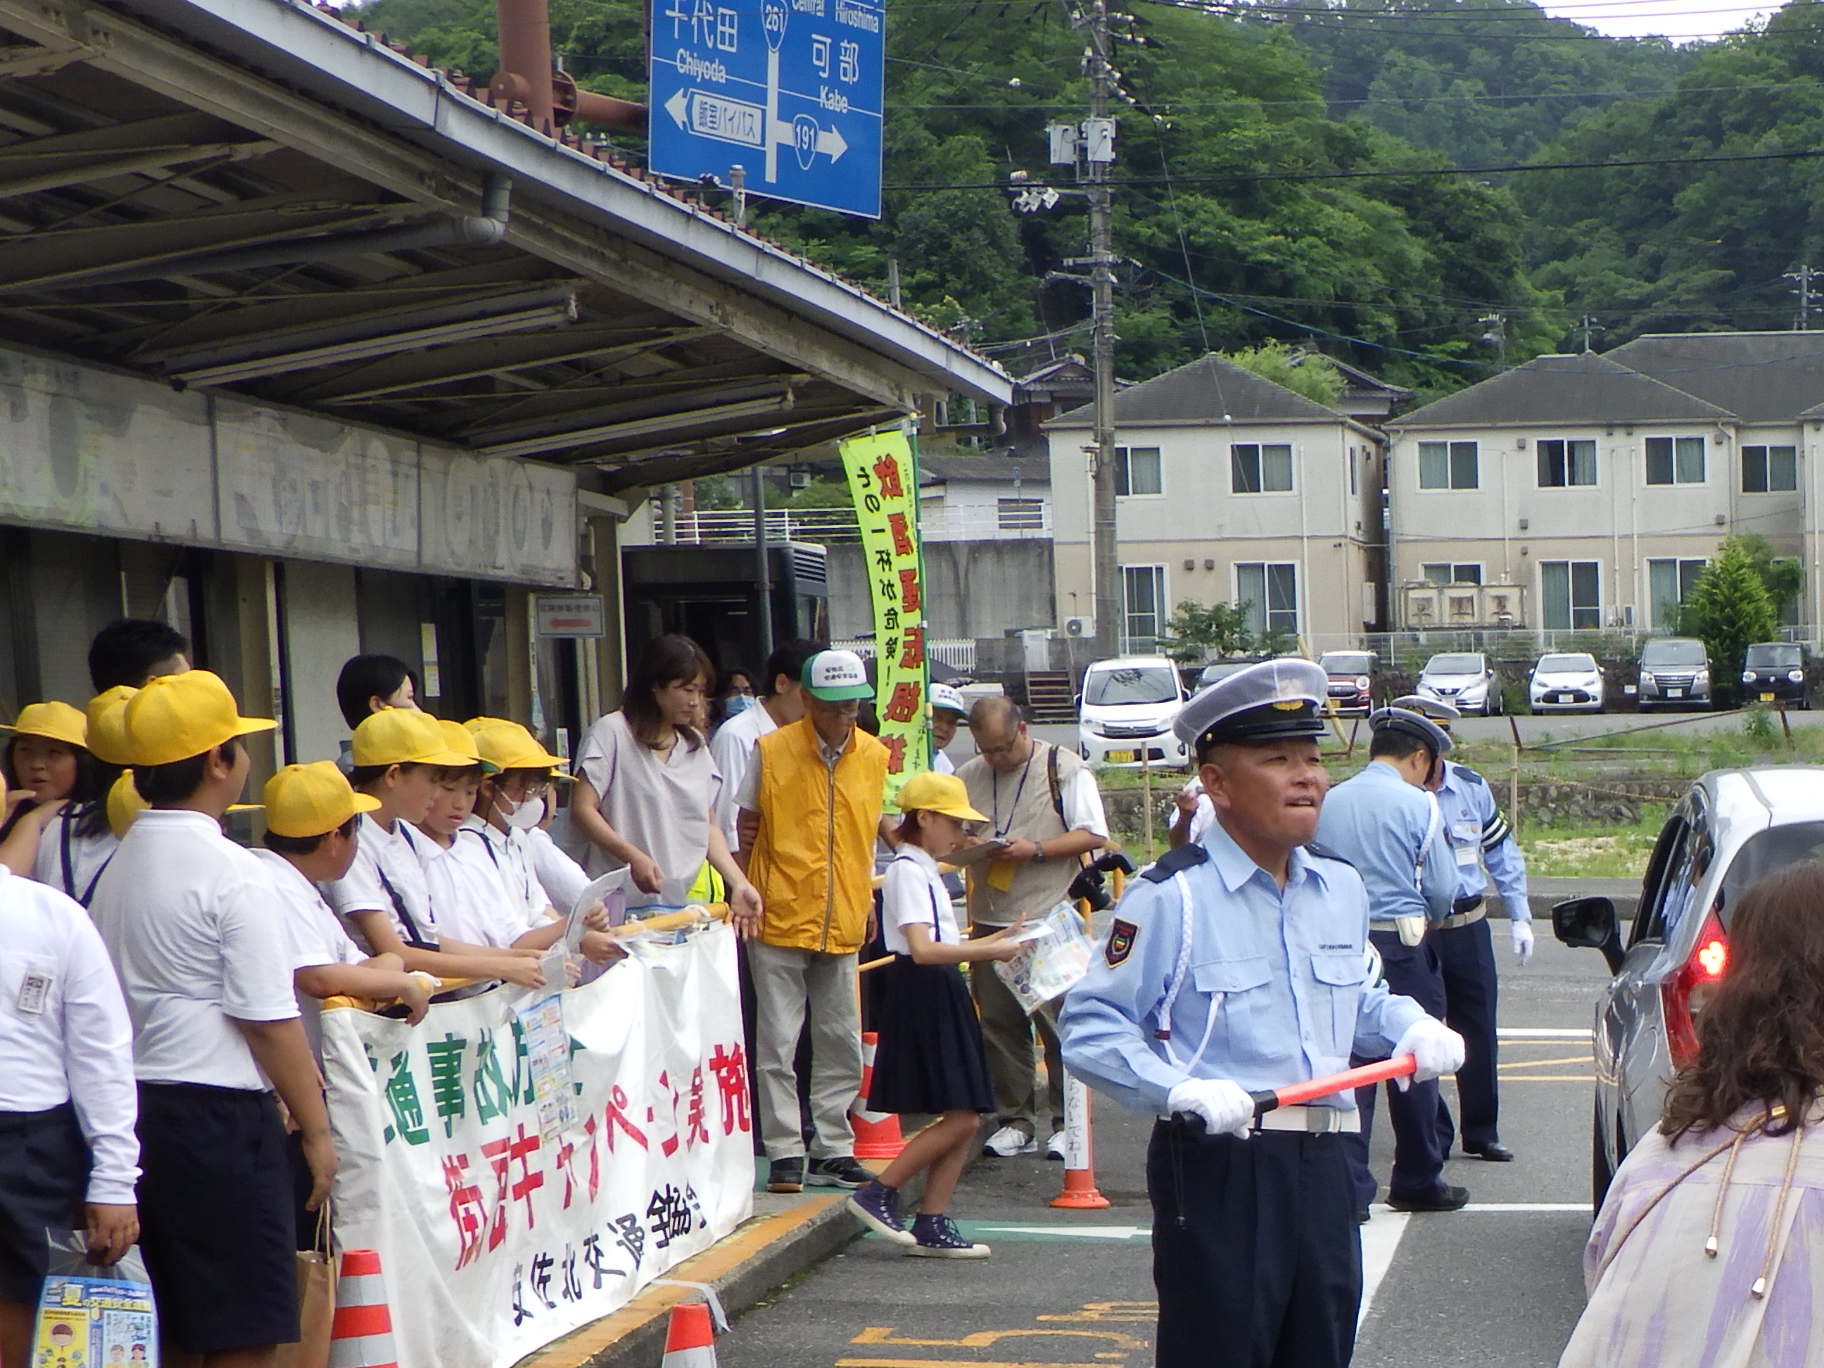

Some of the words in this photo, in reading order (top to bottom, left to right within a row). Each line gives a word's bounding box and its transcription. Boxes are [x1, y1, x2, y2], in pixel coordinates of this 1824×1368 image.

[765, 4, 784, 33] 261
[791, 0, 825, 17] Central
[834, 0, 880, 33] Hiroshima
[676, 48, 727, 84] Chiyoda
[810, 33, 860, 85] 可部
[819, 85, 849, 114] Kabe
[795, 124, 816, 151] 191
[366, 1022, 590, 1147] 通事故
